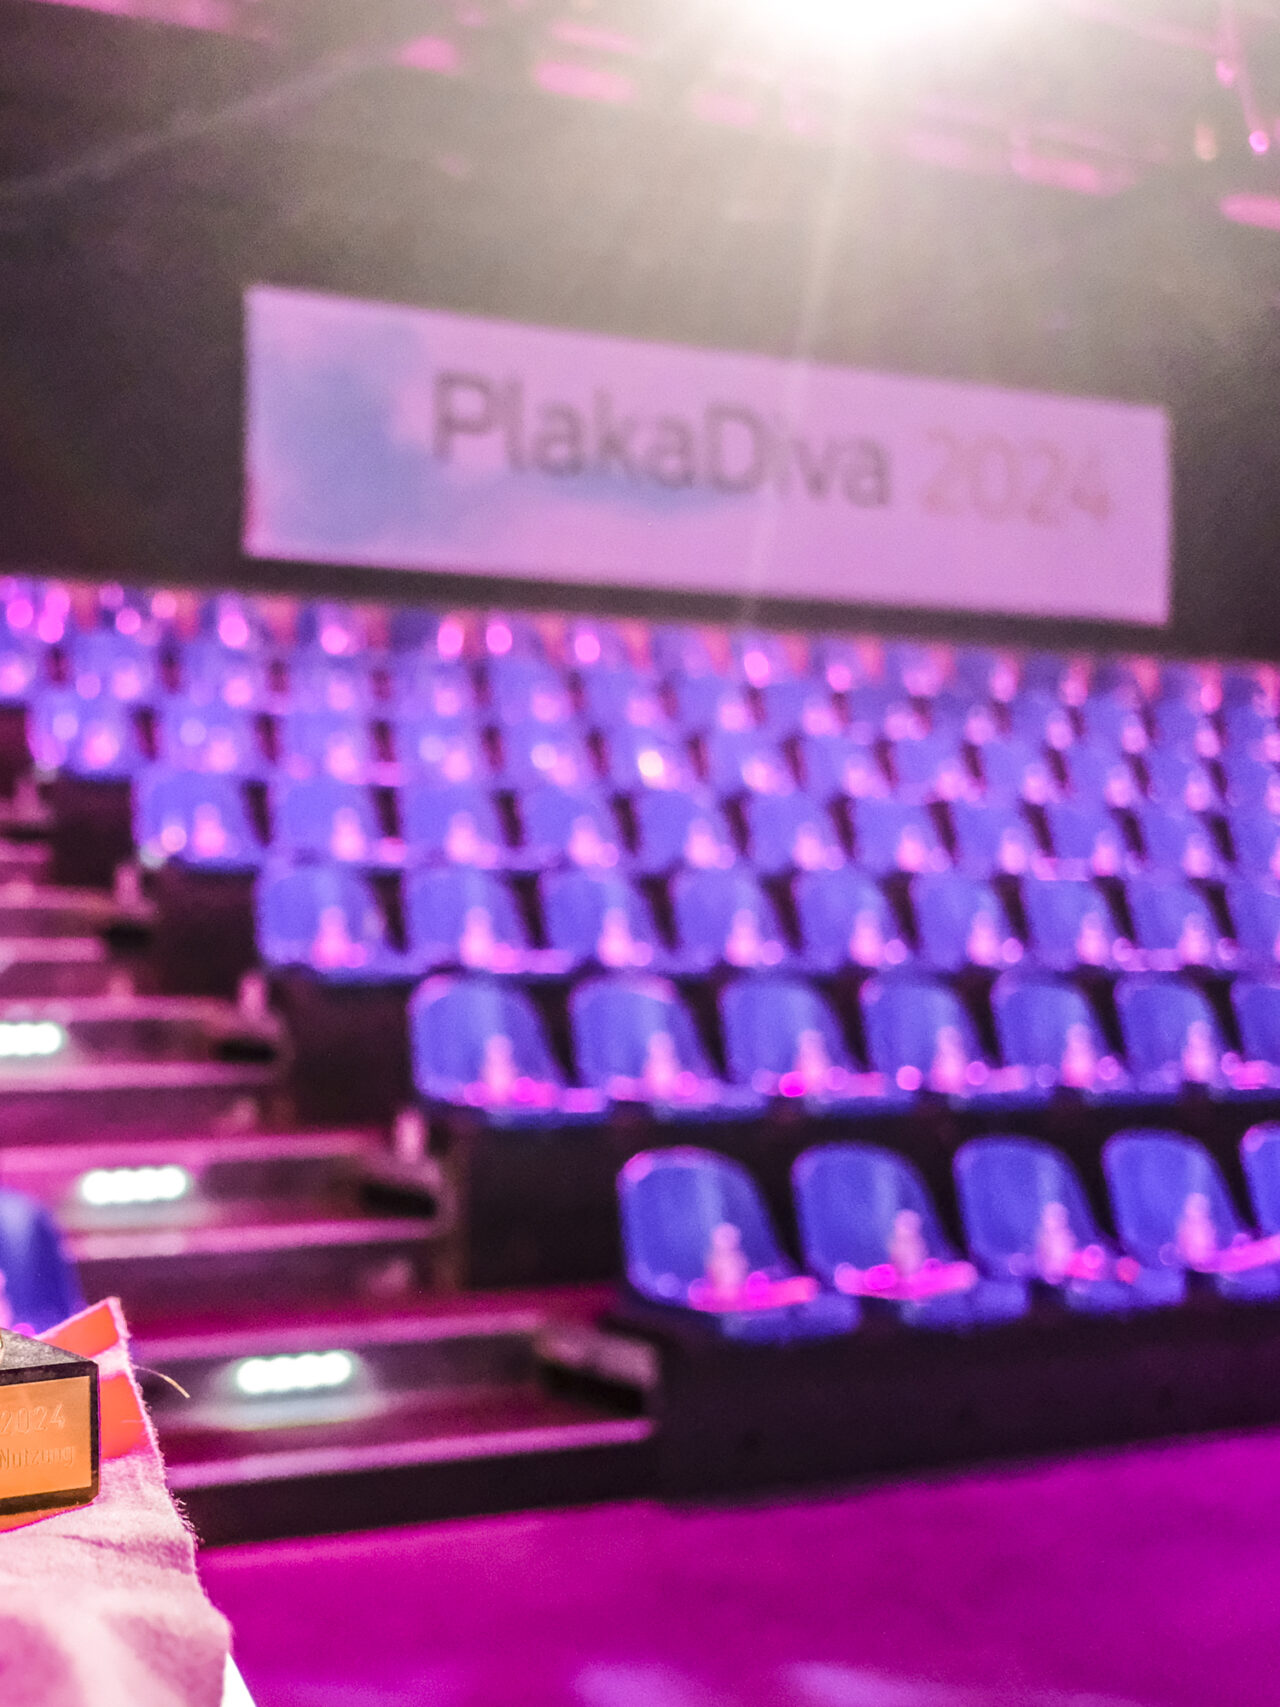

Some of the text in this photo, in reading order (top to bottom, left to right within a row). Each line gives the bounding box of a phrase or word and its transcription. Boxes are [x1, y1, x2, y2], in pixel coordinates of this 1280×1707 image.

[432, 369, 1112, 528] PlakaDiva 2024
[0, 1404, 66, 1436] 2024
